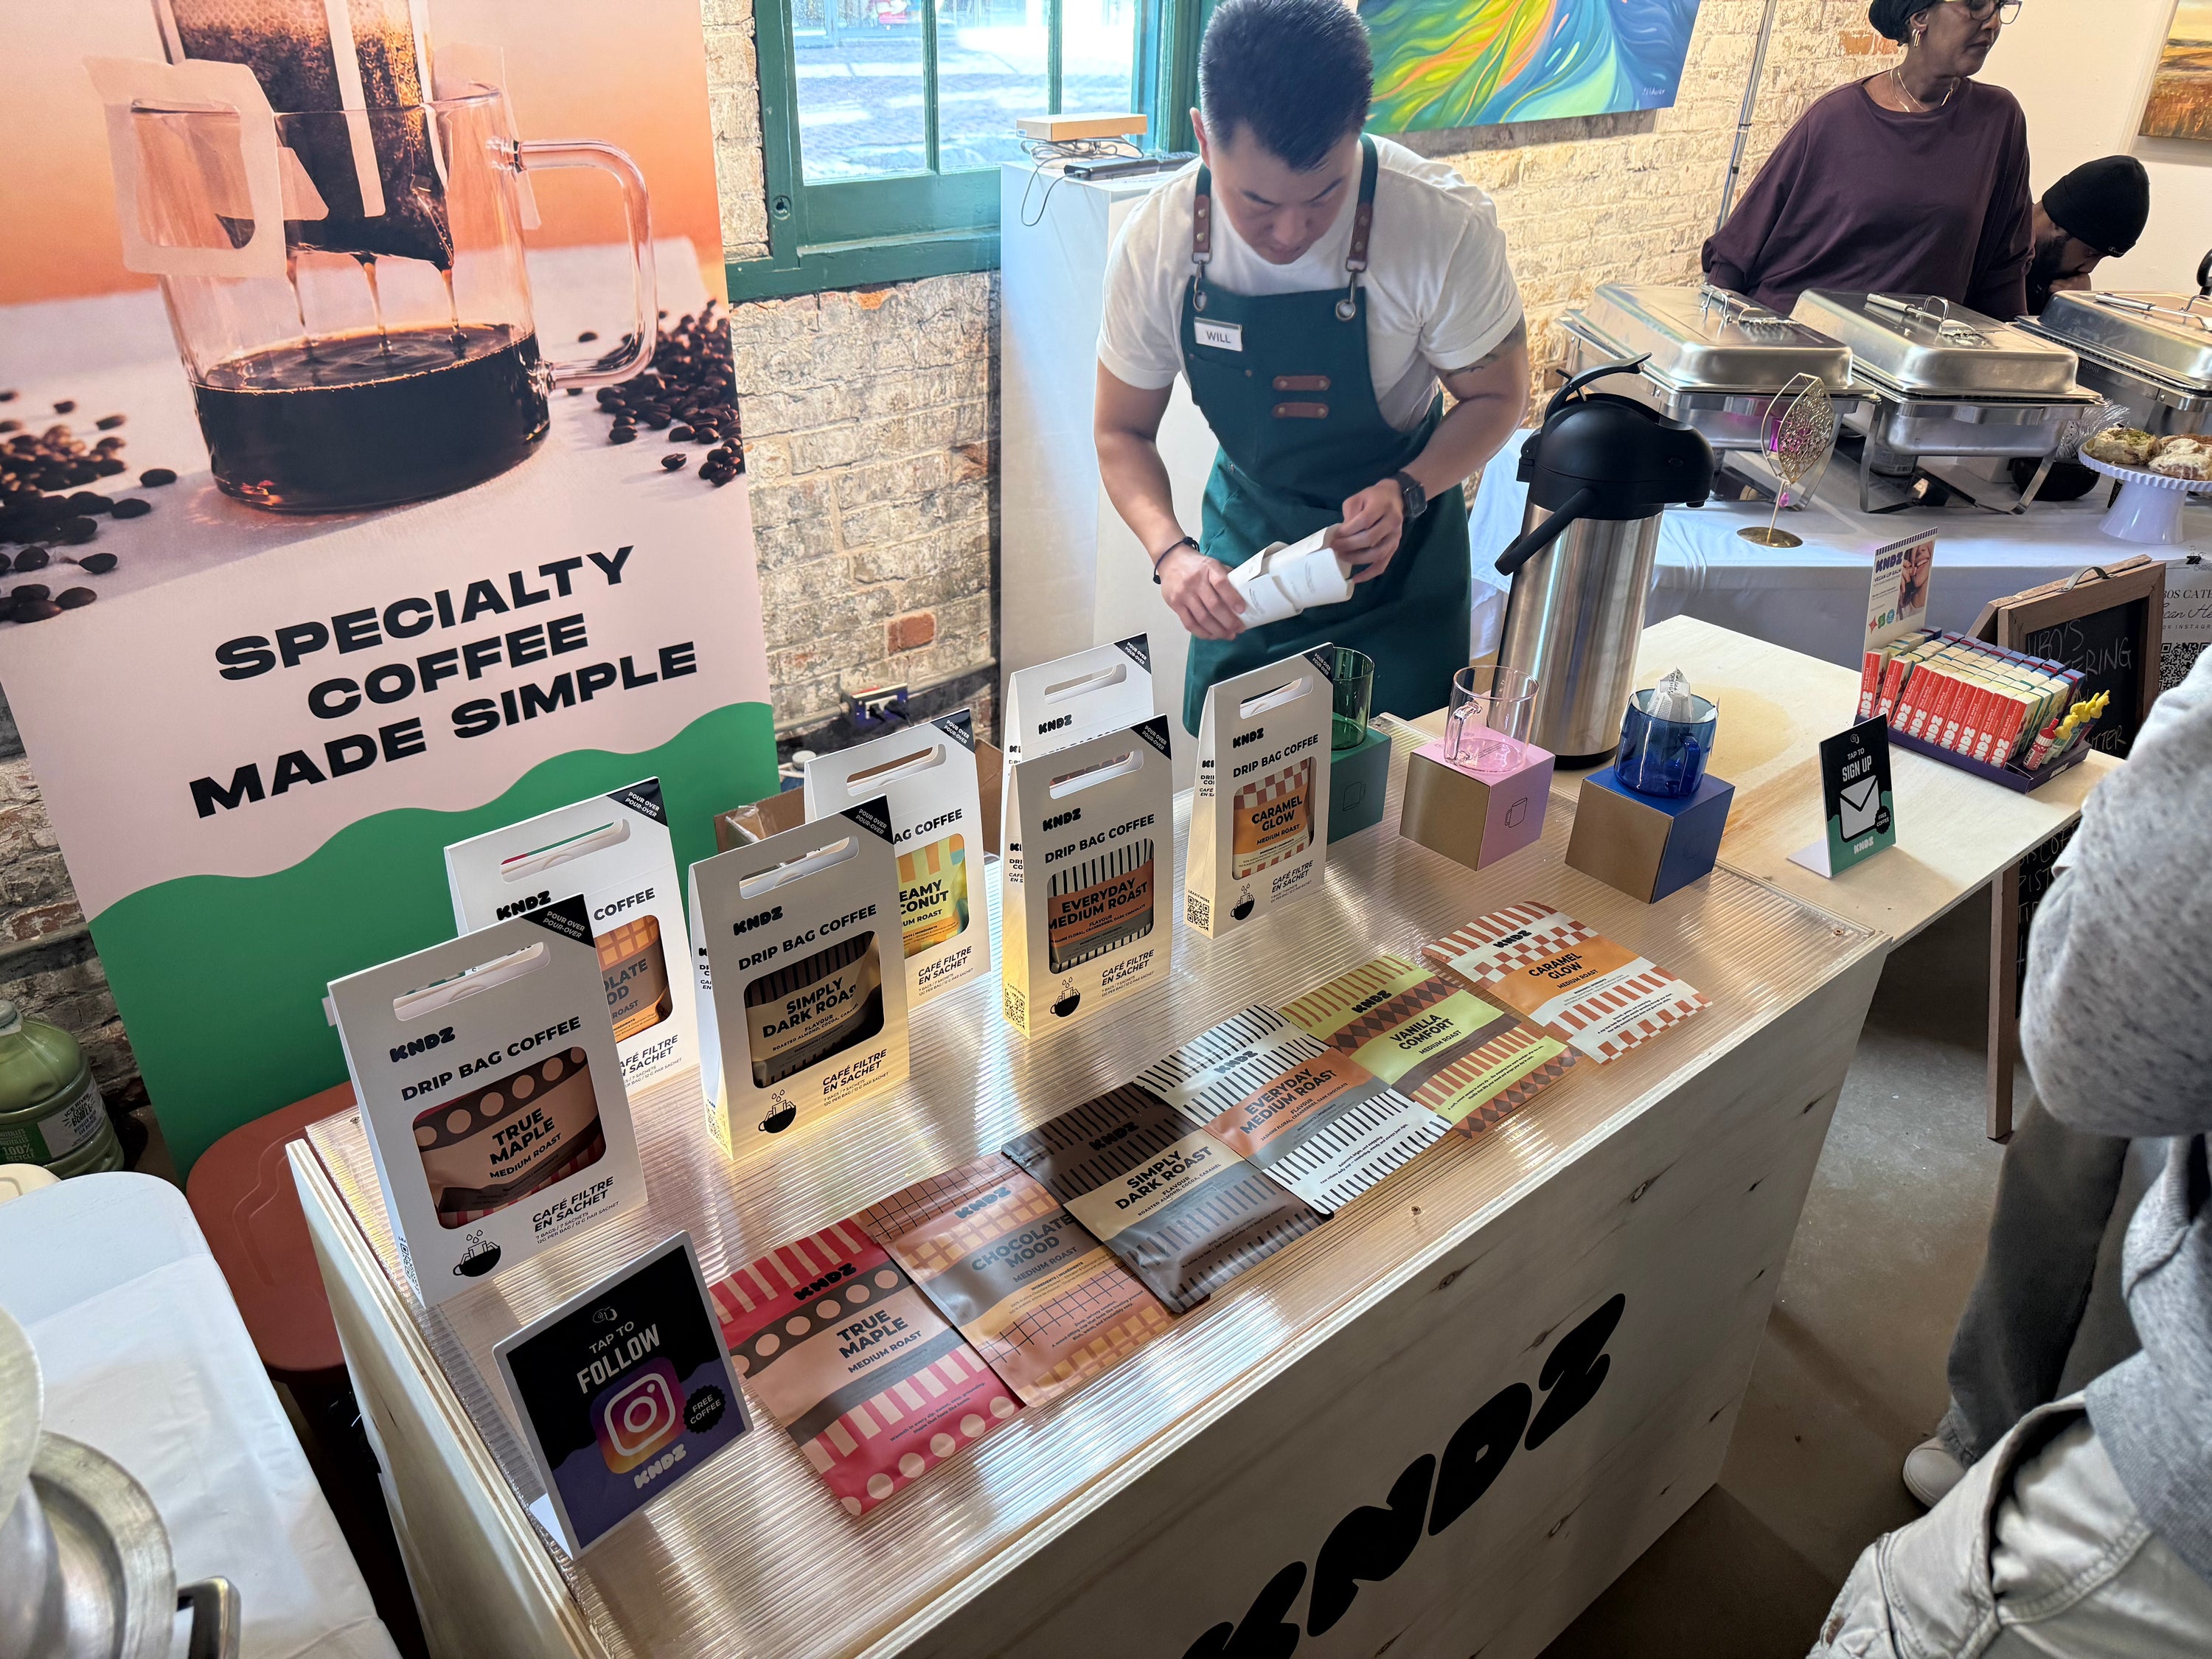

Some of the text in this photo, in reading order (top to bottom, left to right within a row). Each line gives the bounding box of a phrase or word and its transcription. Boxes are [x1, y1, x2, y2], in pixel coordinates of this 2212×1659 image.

[1206, 331, 1231, 343] WILL
[1876, 552, 1903, 573] KNDZ
[1874, 574, 1886, 582] VEGAN
[215, 545, 634, 681] SPECIALTY
[308, 613, 589, 719] COFFEE
[189, 641, 698, 818] MADE SIMPLE
[944, 725, 967, 745] POUR-OVER
[947, 720, 970, 740] POUR OVER
[1038, 714, 1072, 734] KNDZ
[1145, 726, 1166, 745] POUR OVER
[1142, 731, 1164, 750] POUR-OVER
[1233, 728, 1264, 748] KNDZ
[1234, 734, 1318, 778] DRIP BAG COFFEE
[1843, 755, 1872, 782] SIGN UP
[1847, 751, 1857, 760] TAP
[625, 798, 657, 818] POUR-OVER
[628, 791, 660, 812] POUR OVER
[1252, 796, 1303, 824] CARAMEL
[855, 815, 884, 835] POUR-OVER
[858, 808, 887, 830] POUR OVER
[915, 809, 962, 835] COFFEE
[1043, 807, 1081, 832] KNDZ
[1262, 810, 1295, 832] GLOW
[1045, 814, 1155, 864] DRIP BAG COFFEE
[1257, 824, 1300, 845] MEDIUM ROAST
[1854, 836, 1874, 854] KNDZ
[1272, 869, 1309, 893] EN SACHET
[1273, 860, 1313, 886] CAFÉ FILTRE
[496, 891, 552, 921] KNDZ
[594, 888, 655, 921] COFFEE
[1049, 882, 1147, 930] MEDIUM ROAST
[1062, 877, 1135, 914] EVERYDAY
[543, 917, 582, 939] POUR-OVER
[547, 911, 585, 932] POUR OVER
[733, 905, 783, 936] KNDZ
[917, 909, 942, 922] ROAST
[1089, 914, 1113, 927] FLAVOUR
[739, 904, 877, 971] DRIP BAG COFFEE
[1492, 930, 1531, 950] KNDZ
[919, 946, 972, 977] CAFÉ FILTRE
[919, 956, 967, 985] EN SACHET
[1102, 950, 1154, 978] CAFÉ FILTRE
[1102, 959, 1150, 986] EN SACHET
[1528, 953, 1582, 977] CARAMEL
[1548, 962, 1583, 980] GLOW
[1557, 969, 1599, 990] MEDIUM ROAST
[787, 976, 843, 1015] SIMPLY
[1351, 990, 1392, 1015] KNDZ
[612, 1000, 639, 1019] ROAST
[762, 984, 856, 1038] DARK ROAS
[804, 1015, 833, 1032] FLAVOUR
[1390, 1013, 1442, 1043] VANILLA
[1398, 1018, 1455, 1051] COMFORT
[389, 1026, 456, 1063] KNDZ
[642, 1034, 678, 1058] FILTRE
[773, 1038, 797, 1051] ROASTED
[1419, 1029, 1462, 1055] MEDIUM ROAST
[401, 1015, 582, 1101] DRIP BAG COFFEE
[630, 1046, 673, 1073] SACHET
[823, 1048, 887, 1085] CAFÉ FILTRE
[1214, 1051, 1258, 1074] KNDZ
[824, 1060, 881, 1095] EN SACHET
[1239, 1070, 1337, 1135] MEDIUM ROAST
[1245, 1068, 1312, 1115] EVERYDAY
[1290, 1098, 1313, 1114] FLAVOUR
[489, 1116, 555, 1165] MAPLE
[492, 1107, 545, 1147] TRUE
[1088, 1121, 1140, 1151] KNDZ
[490, 1154, 532, 1178] MEDIUM
[533, 1132, 562, 1159] ROAST
[1115, 1178, 1164, 1210] DARK
[1161, 1147, 1212, 1181] ROAST
[1127, 1150, 1181, 1189] SIMPLY
[533, 1176, 613, 1222] CAFÉ FILTRE
[1162, 1177, 1190, 1195] FLAVOUR
[535, 1189, 608, 1232] EN SACHET
[955, 1186, 1012, 1220] KNDZ
[1138, 1202, 1160, 1216] ROASTED
[565, 1211, 588, 1226] SACHETS
[971, 1214, 1073, 1271] CHOCOLATE
[1006, 1236, 1060, 1269] MOOD
[1013, 1246, 1078, 1282] MEDIUM ROAST
[793, 1263, 857, 1301] KNDZ
[589, 1321, 635, 1354] TAP TO
[836, 1310, 891, 1342] TRUE
[838, 1317, 909, 1359] MAPLE
[577, 1324, 661, 1394] FOLLOW
[848, 1348, 891, 1374] MEDIUM
[889, 1329, 922, 1352] ROAST
[690, 1398, 721, 1425] COFFEE
[692, 1394, 714, 1413] FREE
[633, 1444, 686, 1489] KNDZ
